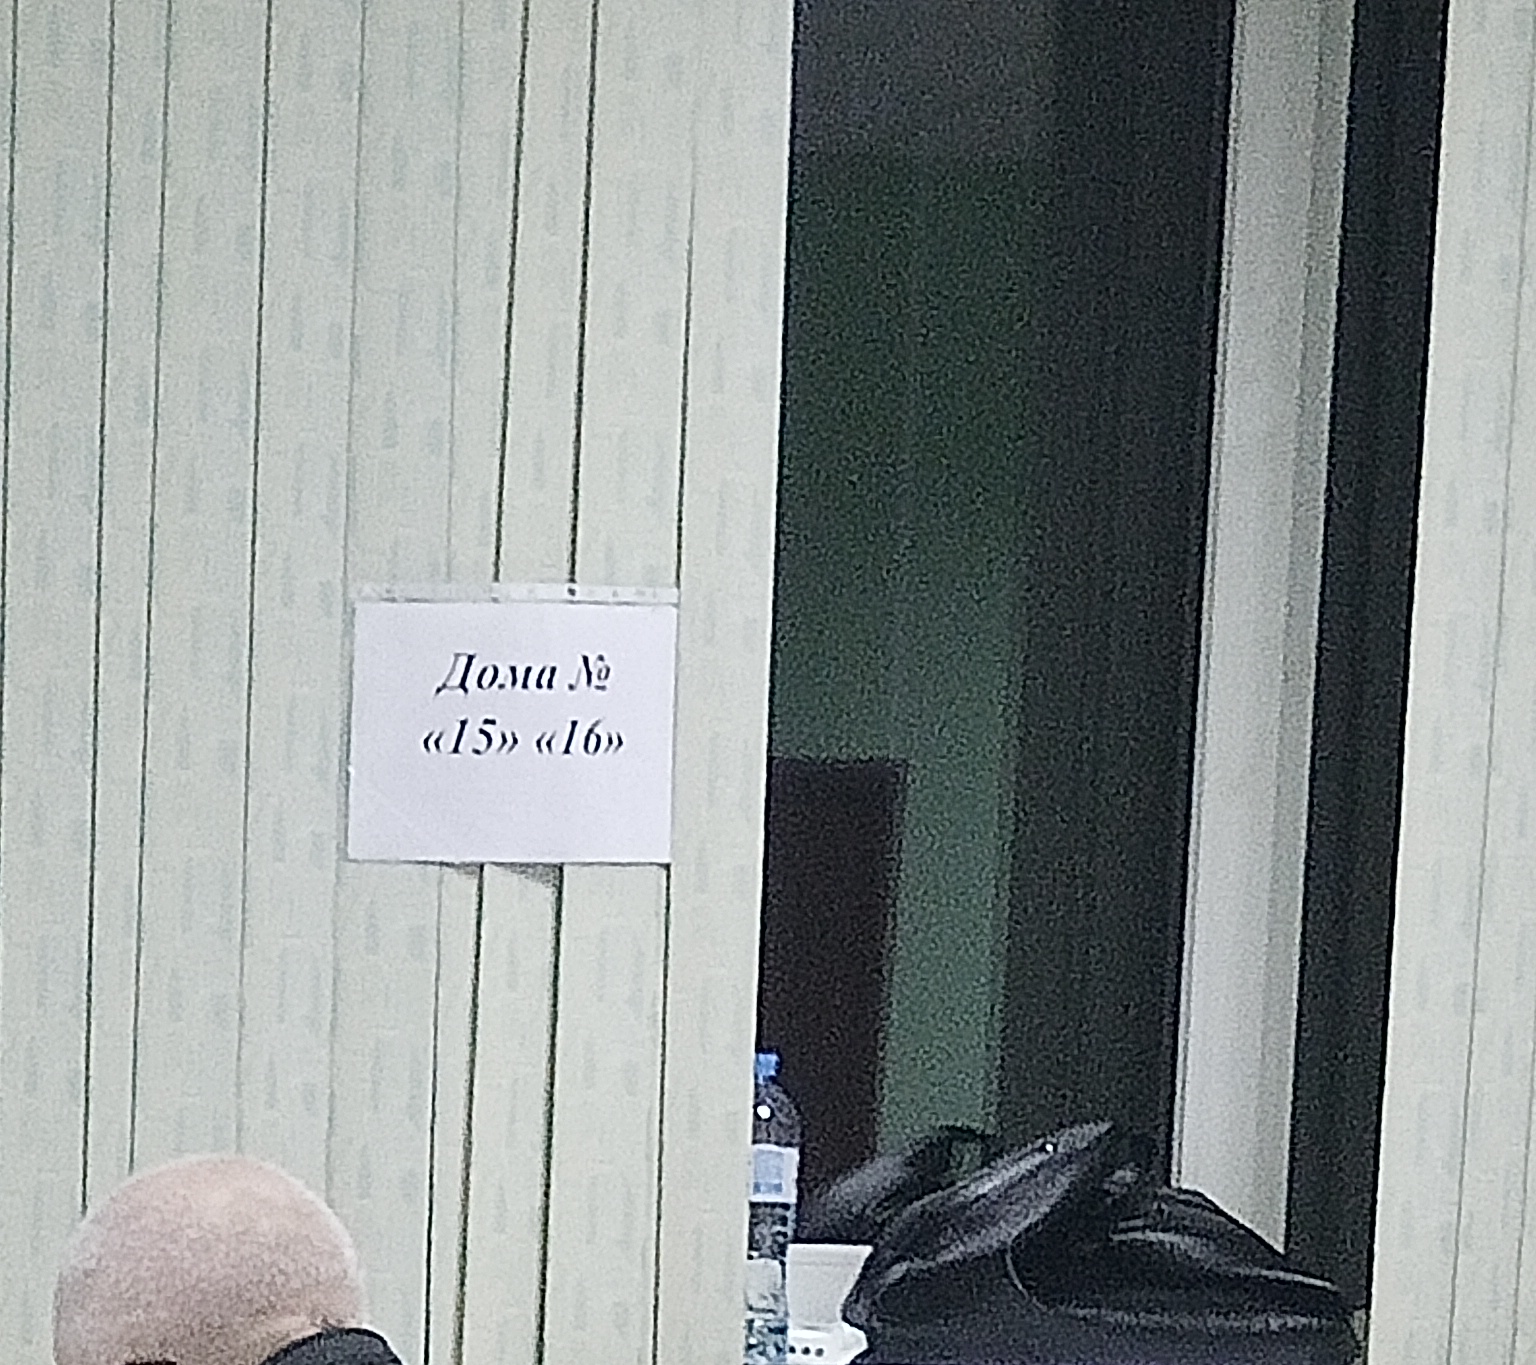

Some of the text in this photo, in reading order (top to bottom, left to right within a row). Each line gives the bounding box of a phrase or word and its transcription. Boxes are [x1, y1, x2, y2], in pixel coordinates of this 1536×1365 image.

[434, 652, 611, 697] Дома №
[422, 717, 624, 756] «15» «16»
